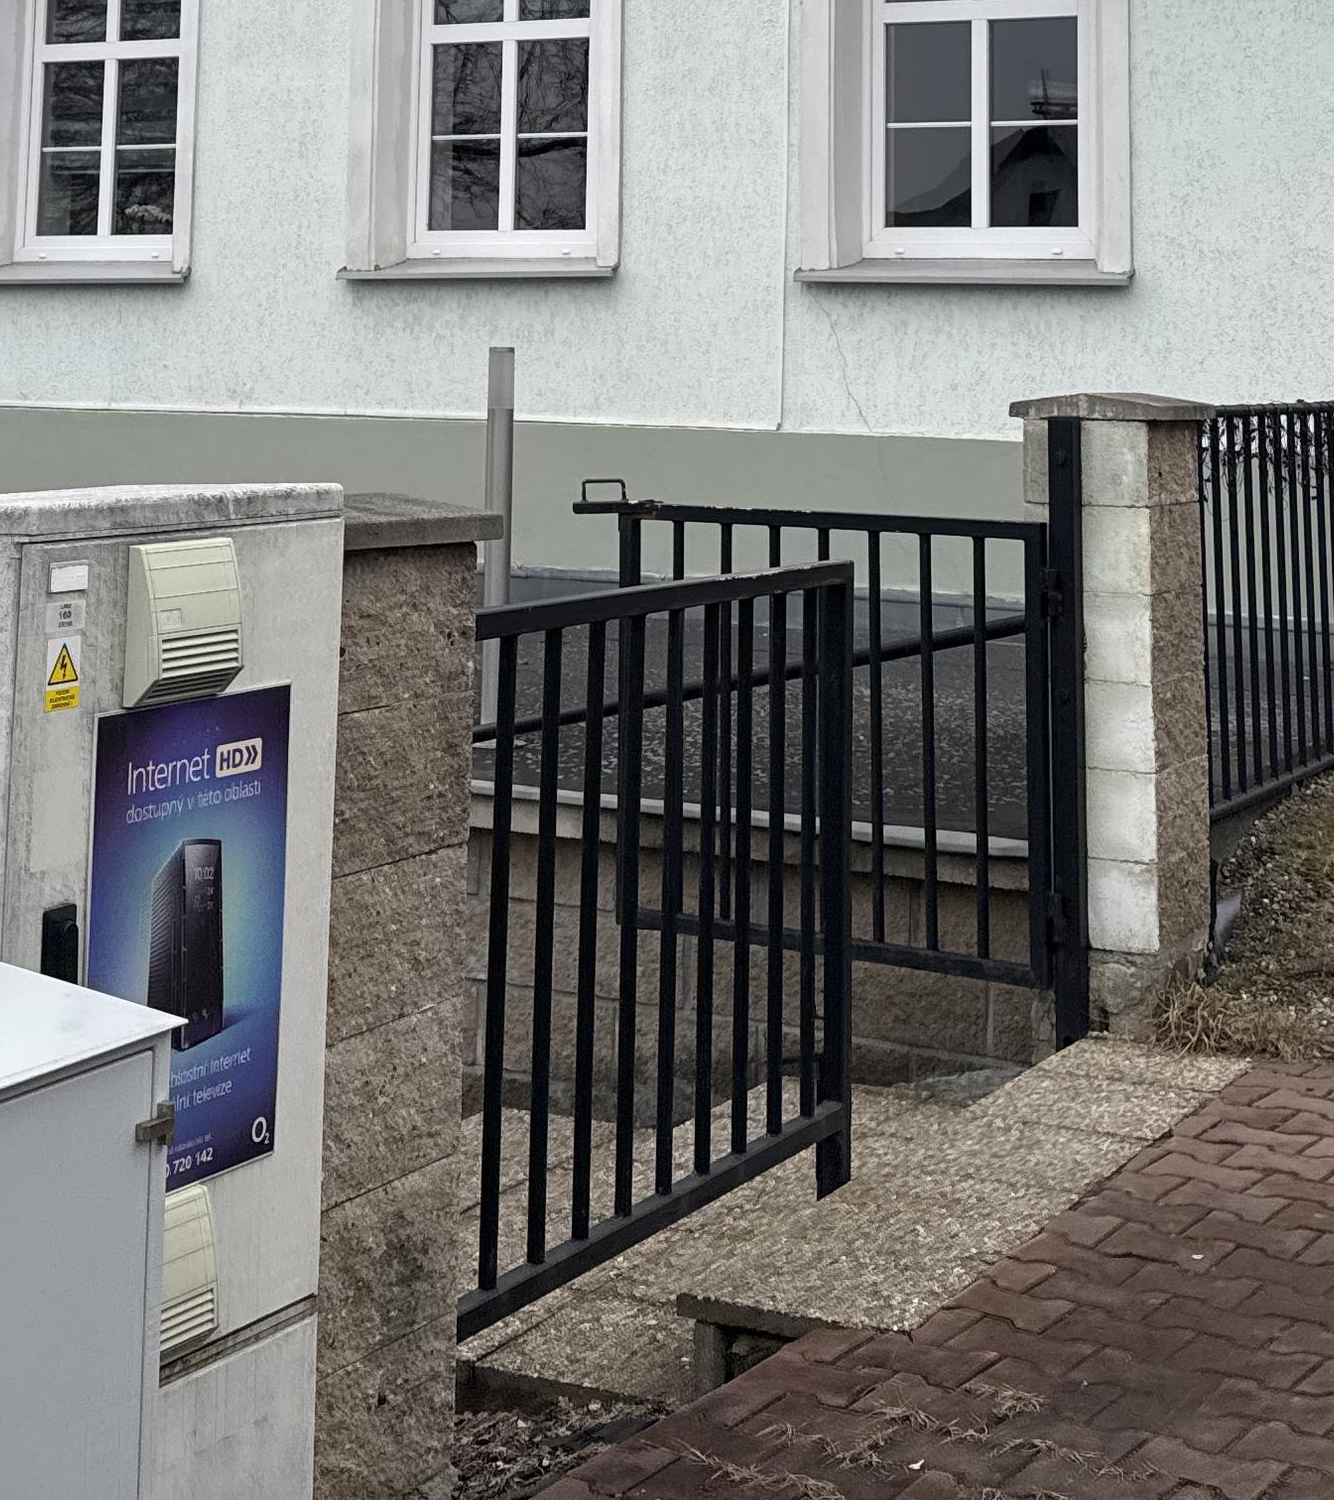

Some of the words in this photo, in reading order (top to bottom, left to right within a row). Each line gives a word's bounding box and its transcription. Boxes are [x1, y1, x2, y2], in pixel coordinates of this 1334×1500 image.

[127, 748, 211, 795] Internet
[219, 747, 244, 771] HD
[126, 795, 184, 824] dostupný
[186, 796, 194, 810] v
[197, 788, 222, 807] této
[224, 779, 261, 800] oblasti
[210, 1047, 251, 1072] internet
[192, 1080, 232, 1106] televize
[173, 1155, 192, 1175] 720
[195, 1147, 214, 1166] 142
